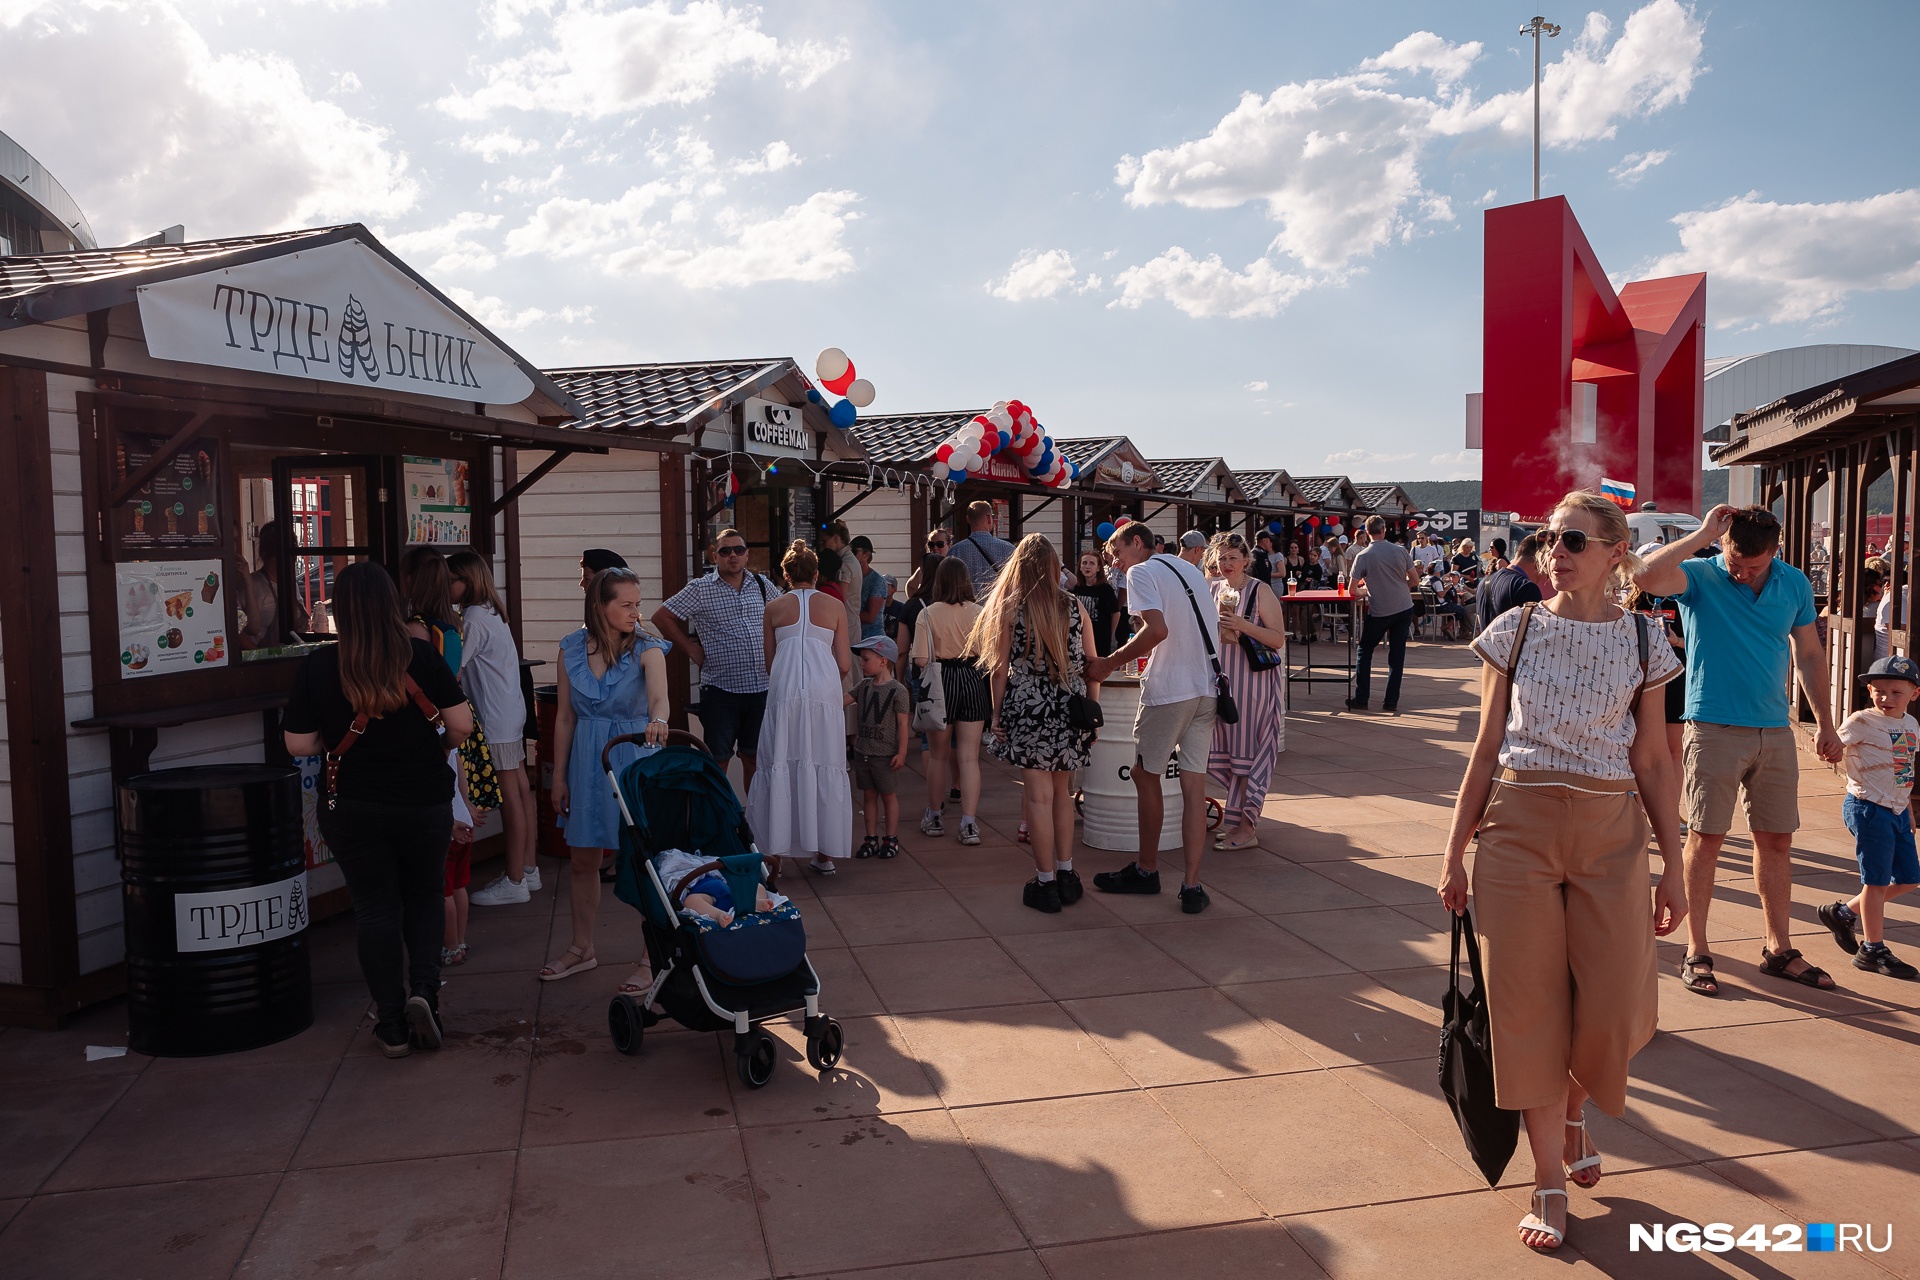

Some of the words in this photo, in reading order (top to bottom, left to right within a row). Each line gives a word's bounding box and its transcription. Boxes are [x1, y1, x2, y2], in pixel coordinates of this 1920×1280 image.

[750, 422, 809, 451] COFFEEMAN
[990, 459, 1020, 478] блины
[1411, 512, 1469, 531] ОФЕ
